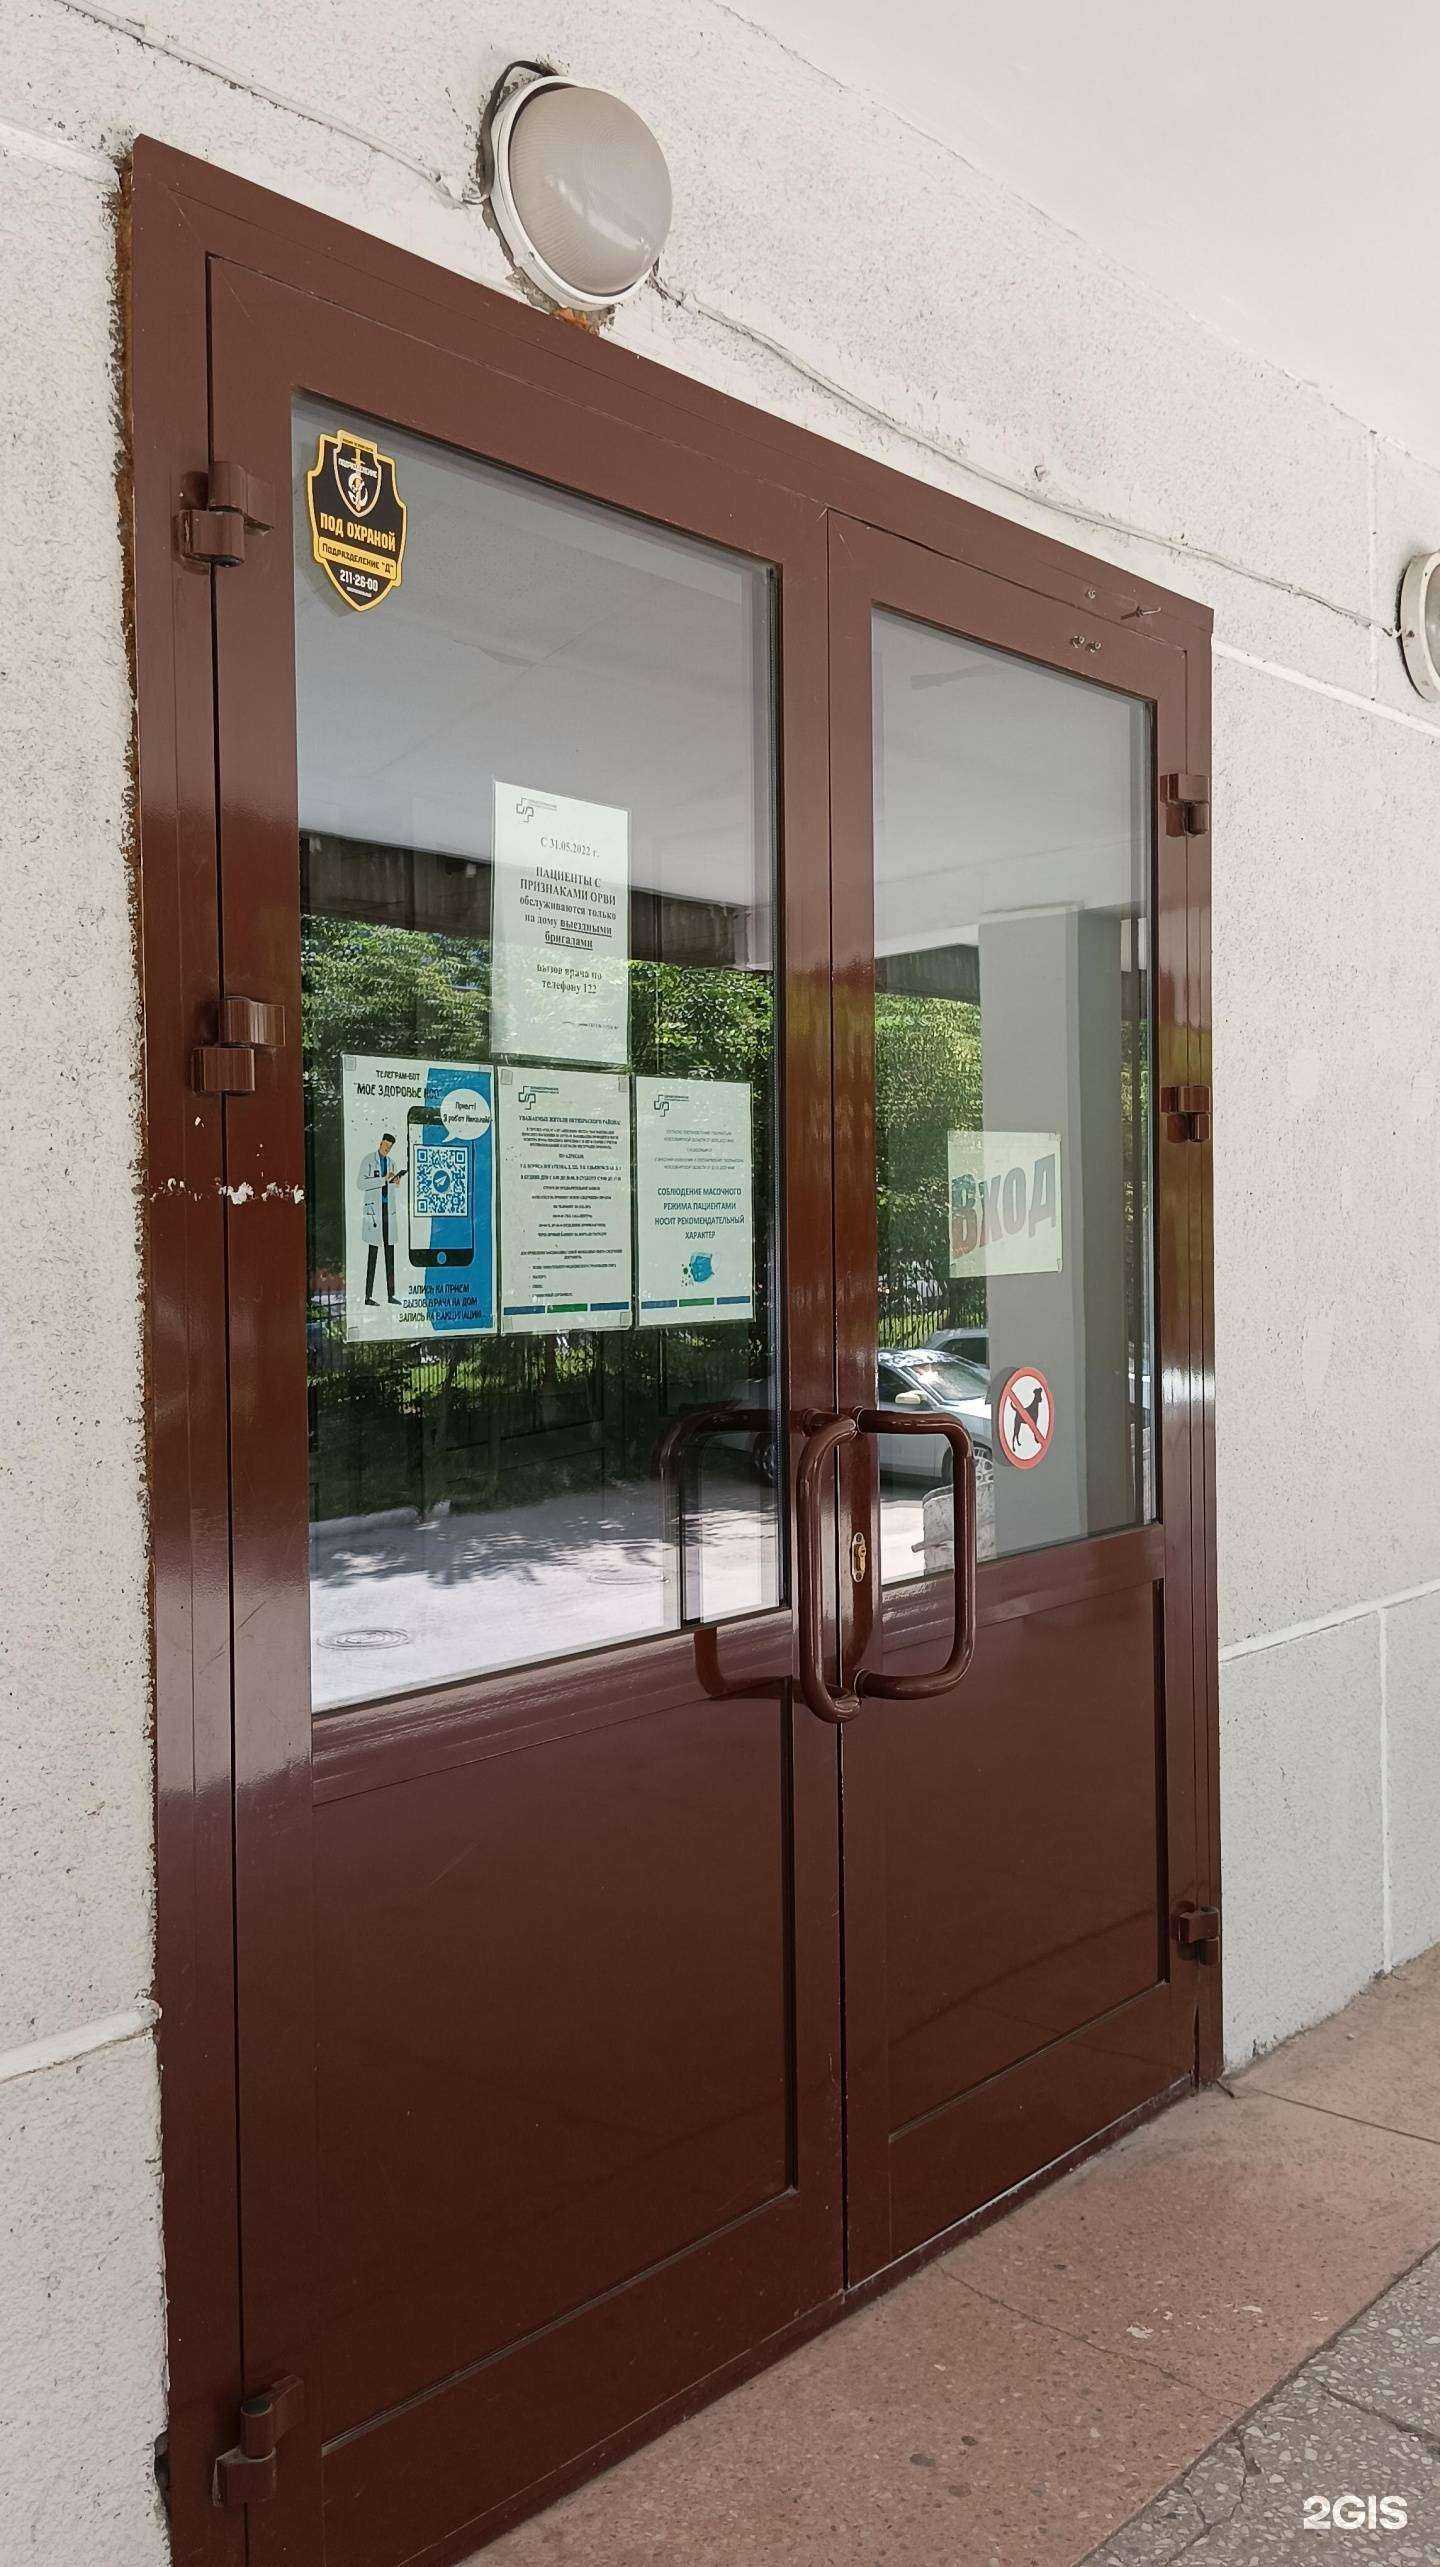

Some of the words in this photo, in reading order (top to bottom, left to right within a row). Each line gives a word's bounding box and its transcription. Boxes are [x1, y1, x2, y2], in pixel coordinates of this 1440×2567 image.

[320, 512, 344, 538] ПОД
[346, 521, 396, 552] ОХРАНОЙ
[339, 569, 379, 592] 211-26-00
[540, 836, 548, 848] С
[549, 838, 592, 856] 31.05.2022
[536, 866, 592, 887] ПАЦИЕНТЫ
[594, 877, 601, 888] С
[520, 878, 588, 902] ПРИЗНАКАМИ
[590, 892, 616, 906] ОРВИ
[519, 895, 586, 917] обслуживаются
[587, 908, 617, 921] только
[525, 913, 535, 923] на
[537, 915, 558, 928] дому
[560, 919, 613, 936] выездными
[544, 930, 594, 949] бригадами
[565, 969, 589, 980] врача
[592, 972, 602, 981] по
[541, 980, 581, 995] телефону
[376, 1069, 420, 1081] ТЕЛЕГРАМ-БОТ
[377, 1085, 422, 1099] ЗДОРОВЬЕ
[449, 1113, 465, 1124] робот
[657, 1187, 702, 1197] СОБЛЮДЕНИЕ
[703, 1187, 742, 1197] МАСОЧНОГО
[663, 1202, 692, 1211] РЕЖИМА
[693, 1202, 737, 1212] ПАЦИЕНТАМИ
[952, 1153, 1056, 1260] ВХОД
[654, 1216, 677, 1226] НОСИТ
[677, 1214, 745, 1226] РЕКОМЕНДАТЕЛЬНЫЙ
[685, 1231, 716, 1240] ХАРАКТЕР
[408, 1284, 434, 1295] ЗАПИСЬ
[403, 1298, 428, 1309] ВЫЗОВ
[462, 1296, 478, 1308] ДОМ
[399, 1312, 426, 1323] ЗАПИСЬ
